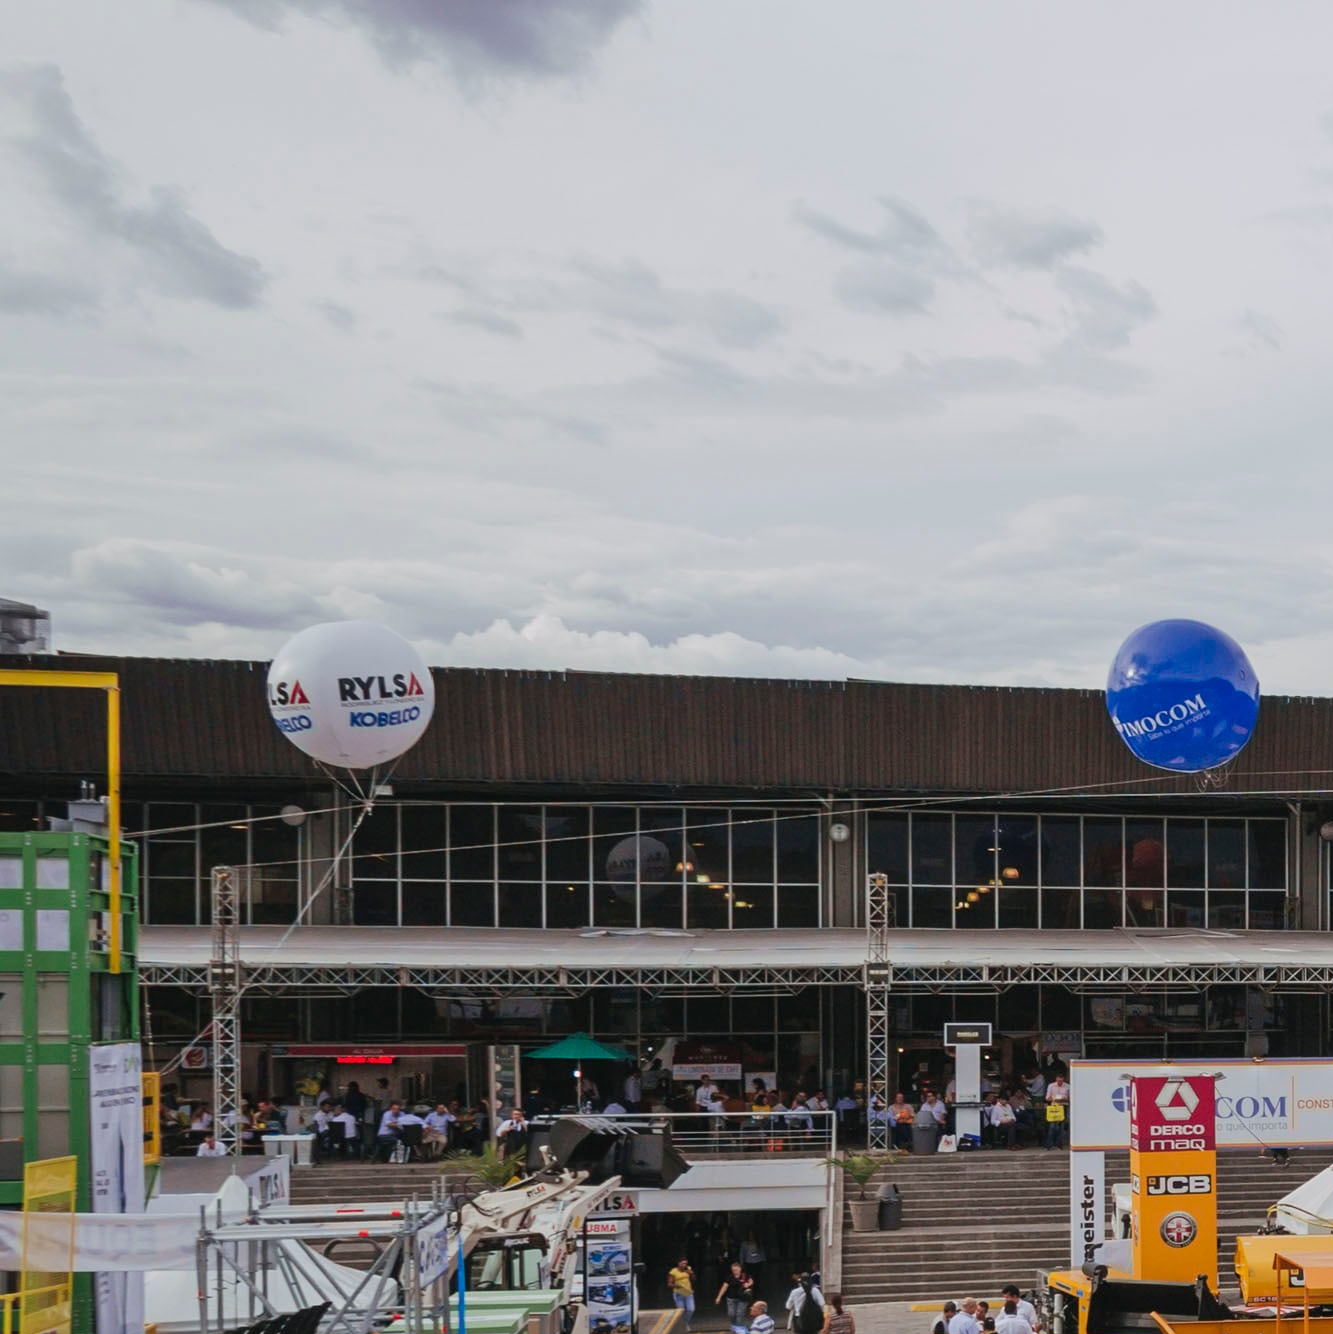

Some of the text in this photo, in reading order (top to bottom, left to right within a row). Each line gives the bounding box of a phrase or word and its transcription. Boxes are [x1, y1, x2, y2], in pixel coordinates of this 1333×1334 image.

[337, 671, 425, 702] RYLSA
[350, 705, 421, 728] KOBELCO
[1122, 693, 1207, 738] IMOCOM
[1150, 1124, 1206, 1136] DERCO
[1147, 1175, 1212, 1195] JCB
